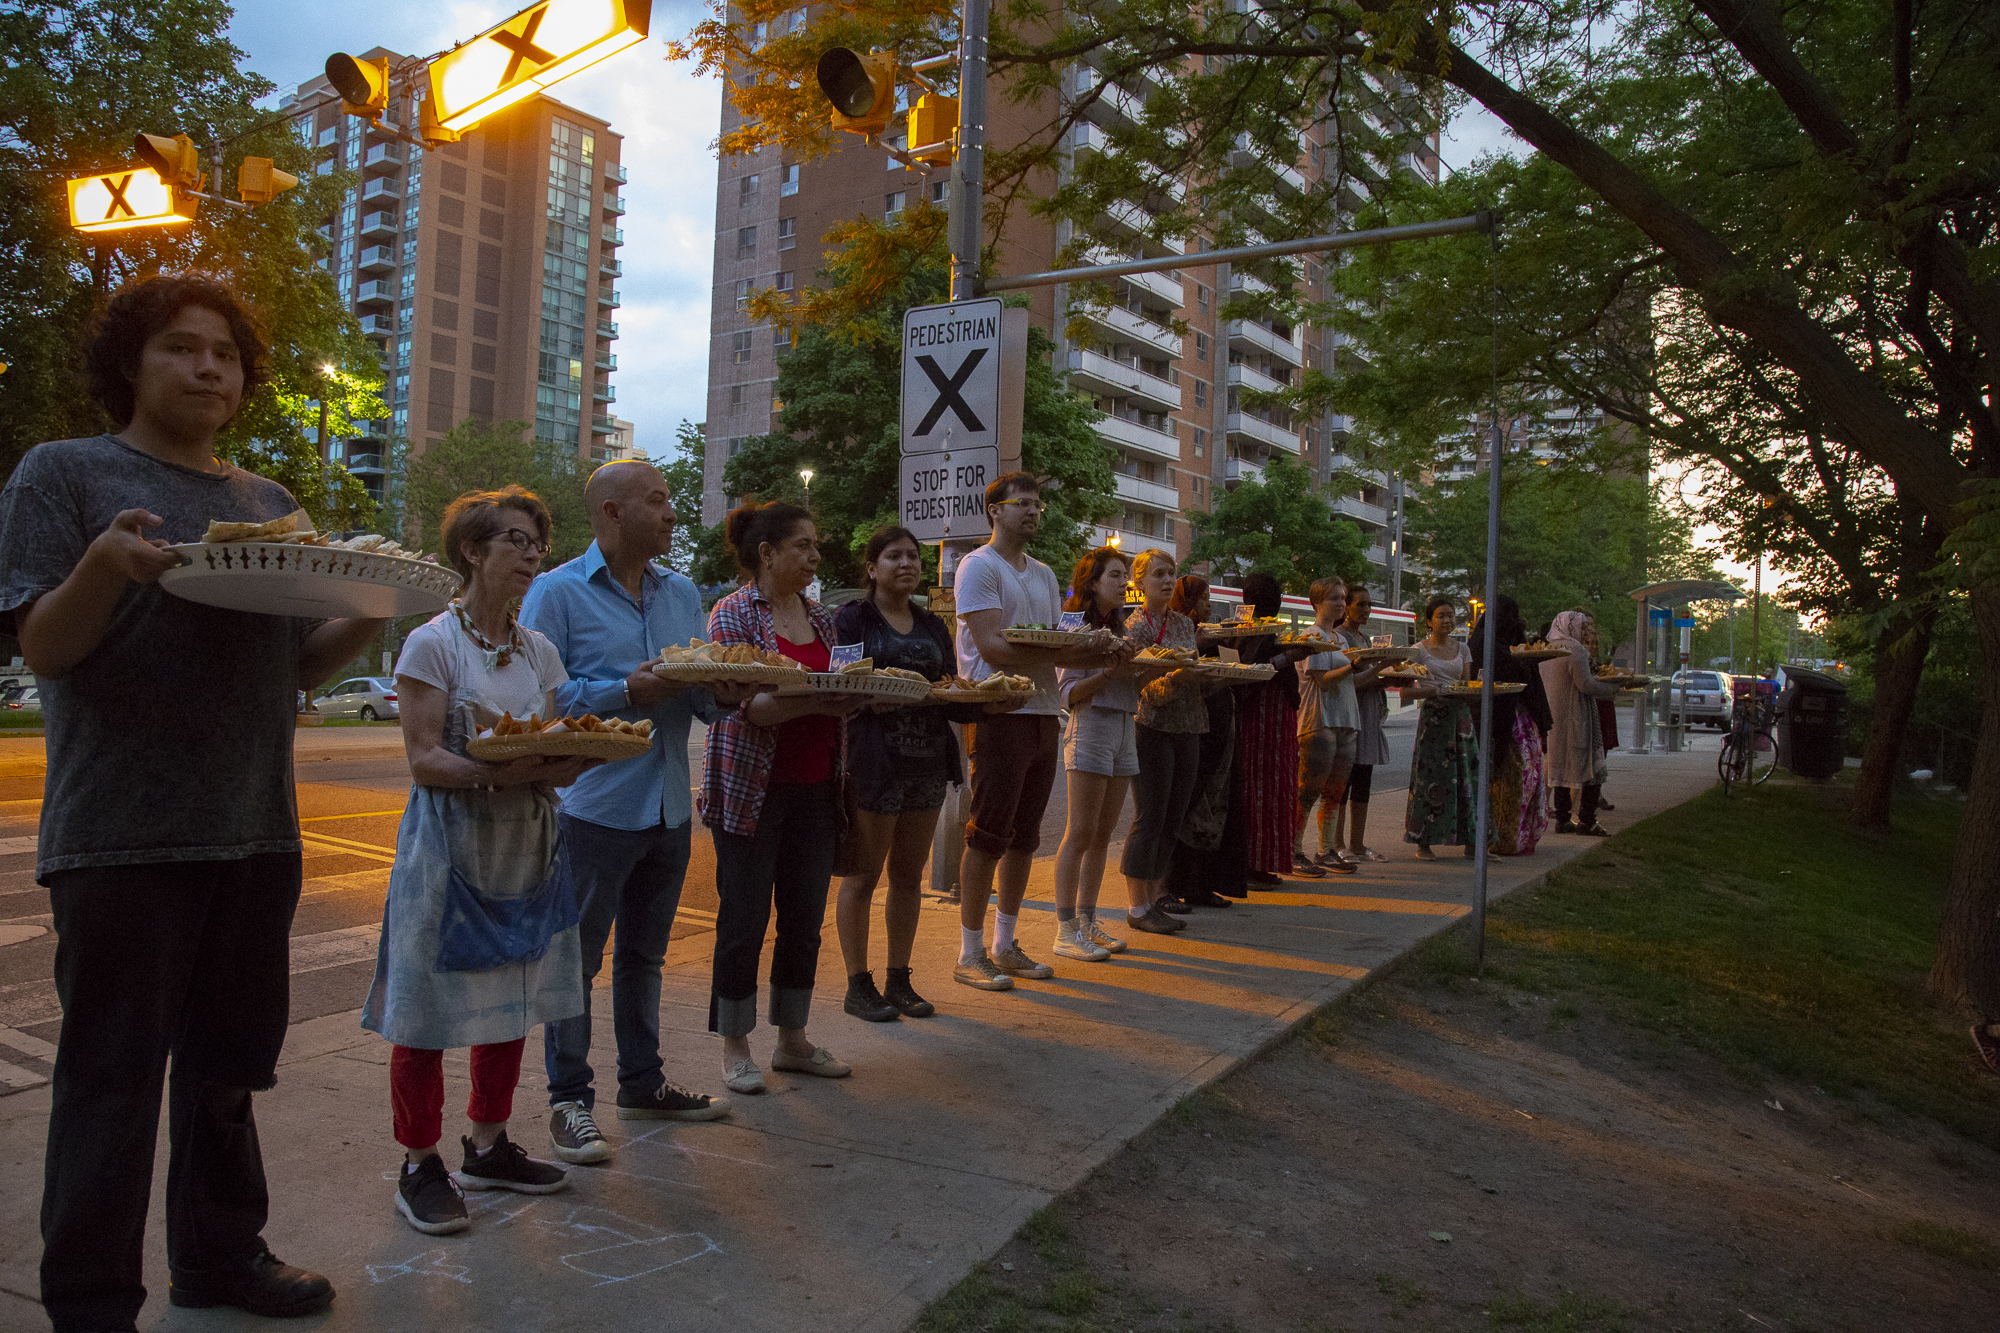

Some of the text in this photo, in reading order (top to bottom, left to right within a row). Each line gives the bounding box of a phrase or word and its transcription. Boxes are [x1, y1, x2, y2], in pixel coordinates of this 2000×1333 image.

[488, 4, 558, 89] X
[101, 173, 137, 220] X
[910, 316, 996, 348] PEDESTRIAN
[911, 347, 990, 437] X
[913, 464, 985, 493] STOP FOR
[905, 493, 984, 522] PEDESTRIAN
